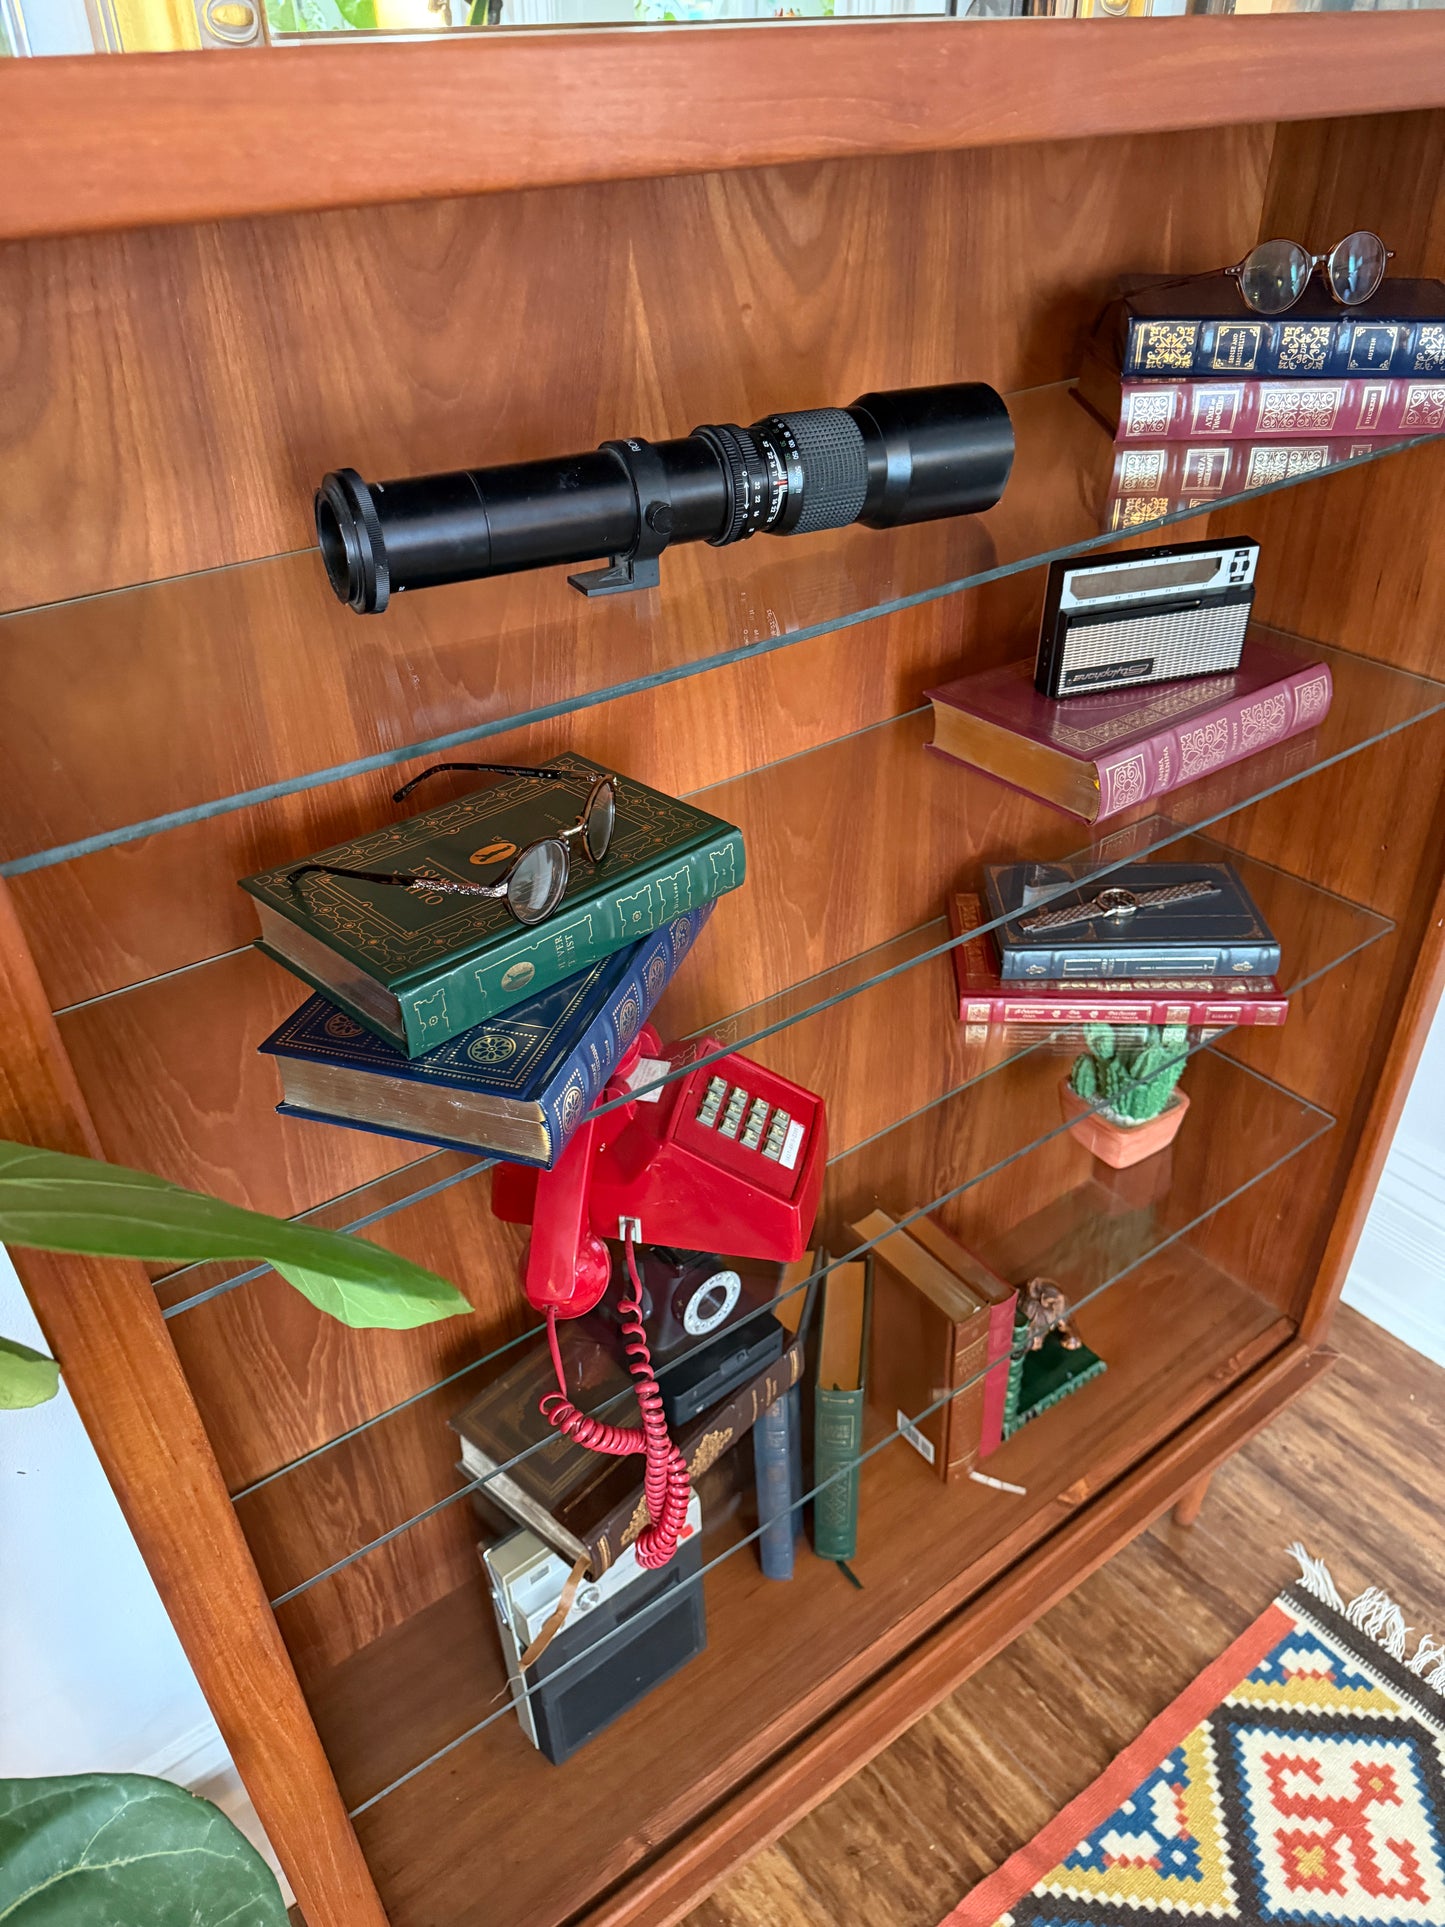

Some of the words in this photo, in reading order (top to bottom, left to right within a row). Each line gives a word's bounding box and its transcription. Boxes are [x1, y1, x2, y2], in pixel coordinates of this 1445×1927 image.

[1231, 333, 1239, 345] AND
[1228, 346, 1237, 363] SENSE
[766, 451, 774, 459] 22
[791, 450, 799, 460] 150
[754, 481, 761, 490] 32
[754, 495, 761, 504] 22
[1072, 663, 1150, 682] Stylophone
[564, 934, 576, 967] TIST
